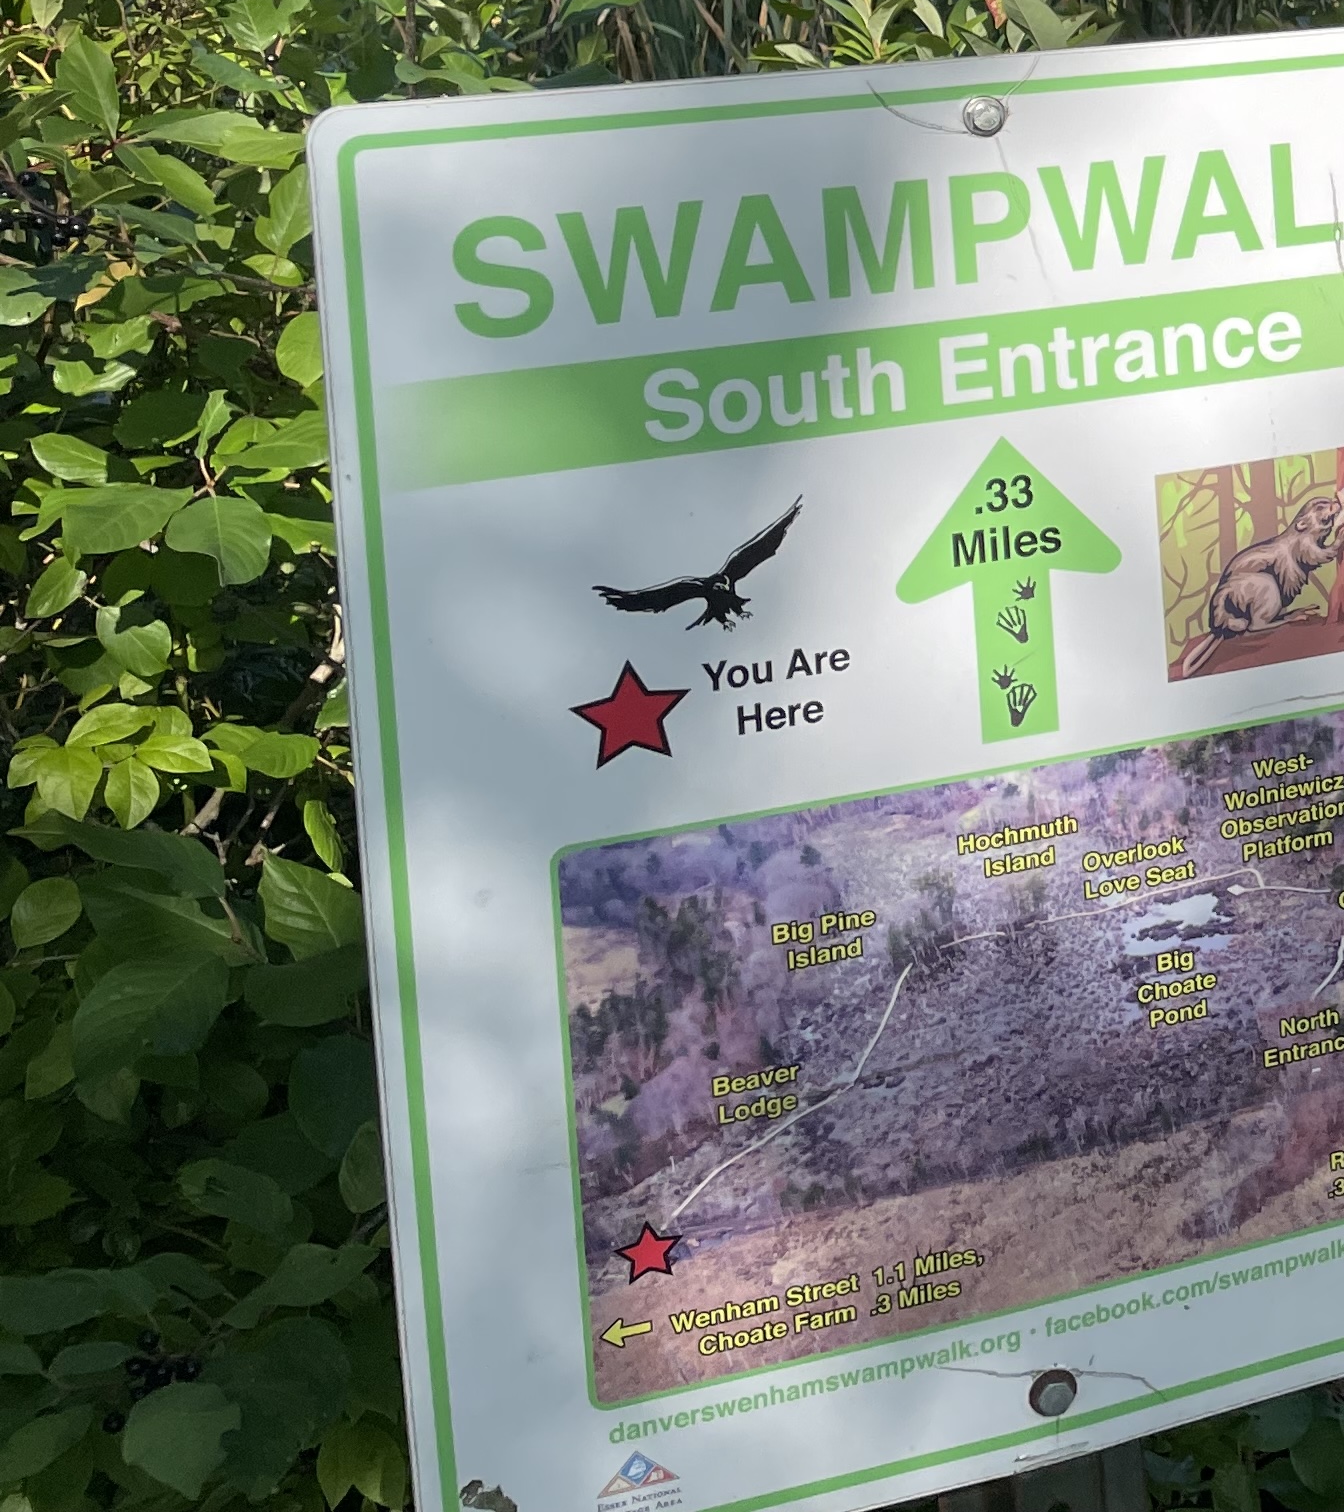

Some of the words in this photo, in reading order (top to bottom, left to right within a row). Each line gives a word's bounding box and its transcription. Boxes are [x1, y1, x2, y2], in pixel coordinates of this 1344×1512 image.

[644, 347, 906, 442] South
[938, 311, 1302, 406] Entrance
[974, 474, 1034, 514] .33
[952, 526, 1062, 567] Miles
[702, 655, 773, 691] You
[785, 647, 851, 680] Are
[736, 699, 824, 735] Here
[1252, 753, 1314, 780] West-
[1224, 773, 1344, 812] Wolniewicz
[957, 816, 1078, 855] Hochmuth
[1242, 829, 1334, 862] Platform
[984, 846, 1055, 878] Island
[1082, 836, 1185, 872] Overlook
[1084, 874, 1141, 900] Love
[1146, 861, 1197, 889] Seat
[771, 921, 814, 945] Big
[821, 910, 876, 936] Pine
[787, 937, 863, 971] Island
[1156, 950, 1195, 974] Big
[1137, 972, 1217, 1005] Choate
[1149, 1000, 1208, 1029] Pond
[1280, 1007, 1340, 1039] North
[711, 1063, 800, 1097] Beaver
[718, 1092, 798, 1125] Lodge
[671, 1293, 779, 1334] Wenham
[785, 1274, 860, 1306] Street
[872, 1262, 907, 1287] 1.1
[914, 1247, 985, 1278] Miles,
[698, 1322, 788, 1355] Choate
[794, 1303, 857, 1334] Farm
[871, 1294, 892, 1317] .3
[898, 1280, 962, 1310] Miles
[609, 1329, 1021, 1445] danverswenhamswampwalk.org
